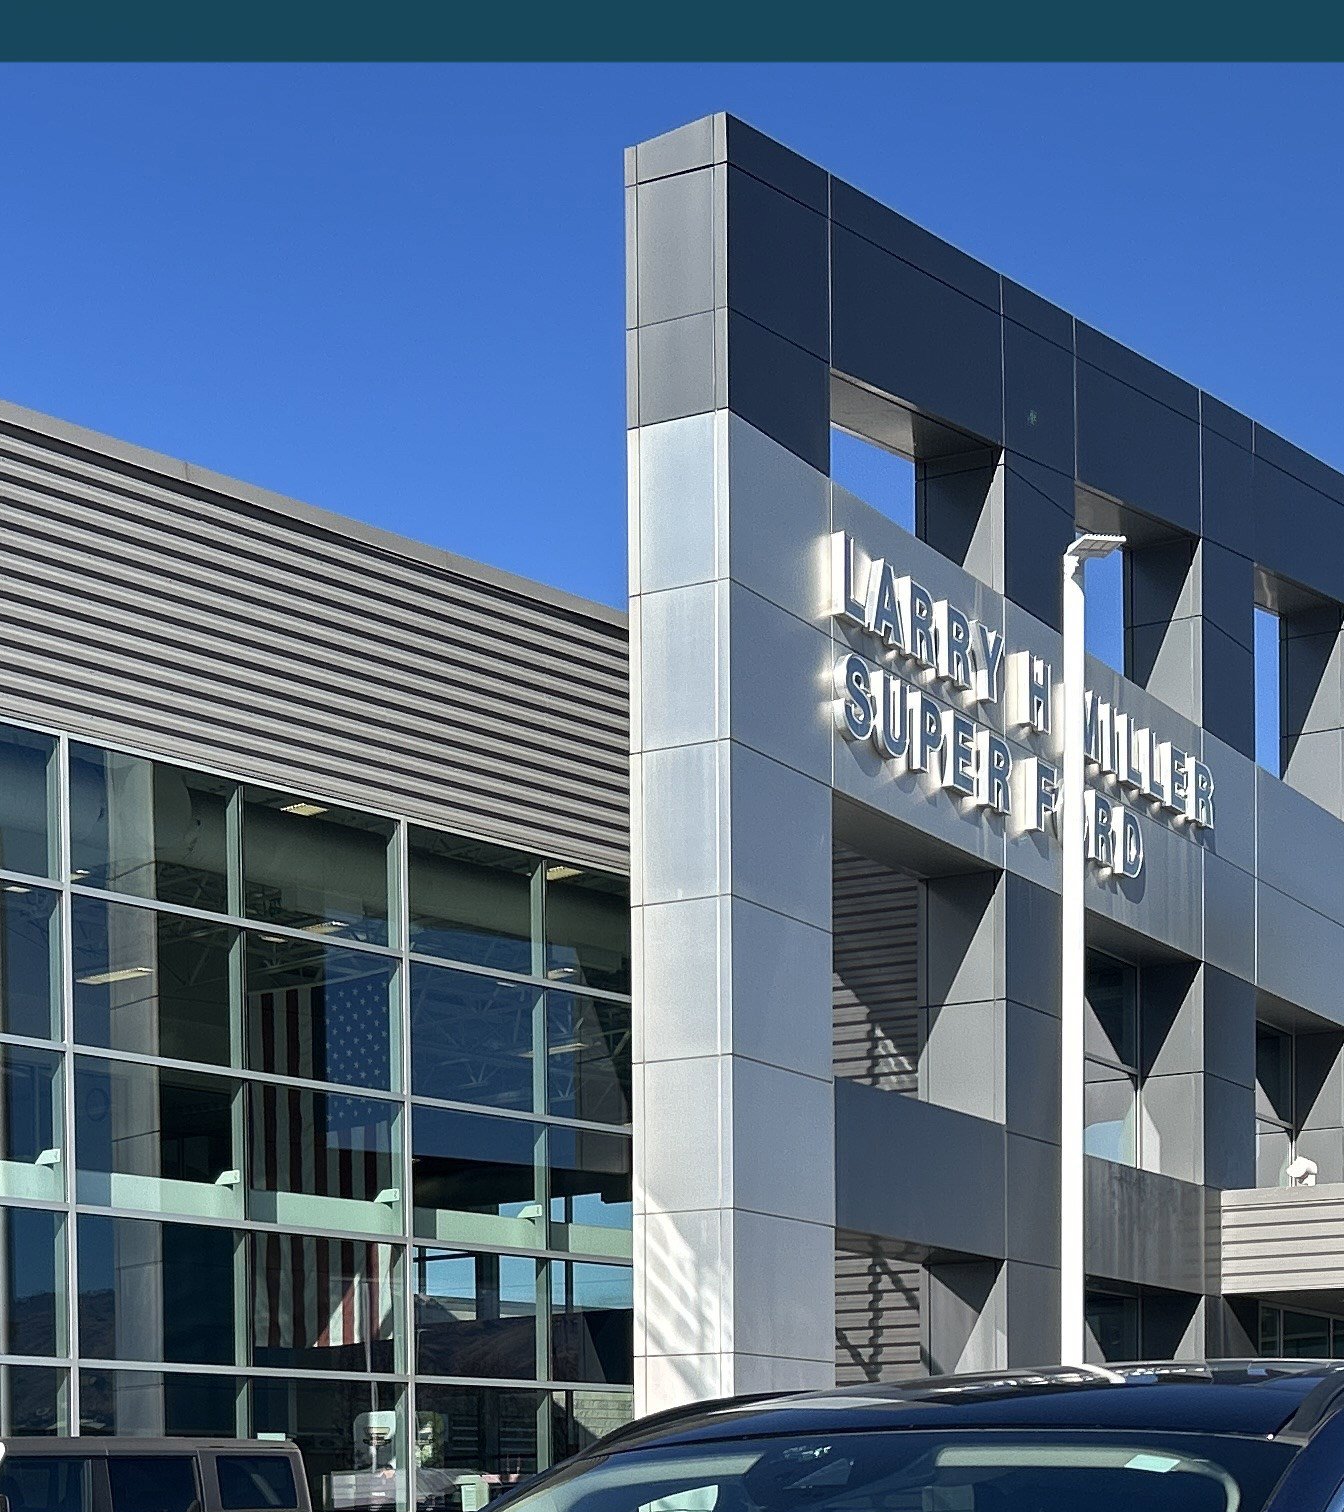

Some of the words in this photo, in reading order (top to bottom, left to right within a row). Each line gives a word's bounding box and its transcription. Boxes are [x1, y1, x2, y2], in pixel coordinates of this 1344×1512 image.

[830, 530, 1005, 704] LARRY
[1008, 650, 1052, 735] H
[833, 653, 1012, 816] SUPER
[1024, 757, 1144, 878] FRD
